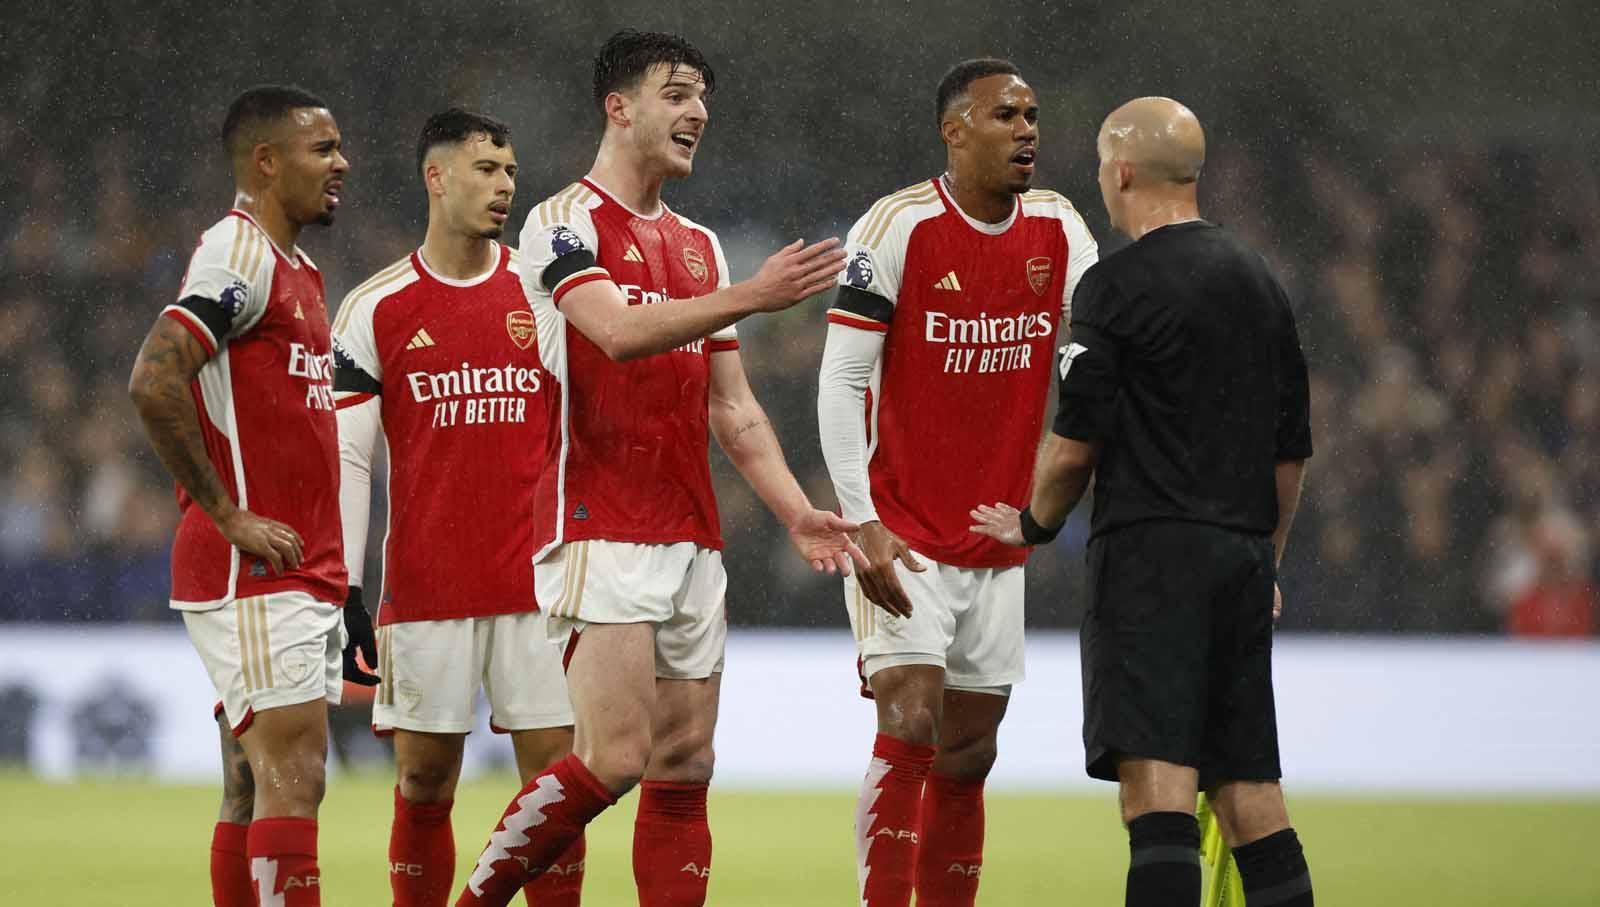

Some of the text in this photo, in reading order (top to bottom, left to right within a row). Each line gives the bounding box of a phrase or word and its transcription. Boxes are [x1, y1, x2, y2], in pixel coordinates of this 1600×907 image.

[925, 311, 1053, 344] Emirates
[943, 343, 1032, 373] FLY BETTER
[406, 362, 541, 402] Emirates
[432, 397, 526, 428] FLY BETTER
[283, 875, 320, 890] AF
